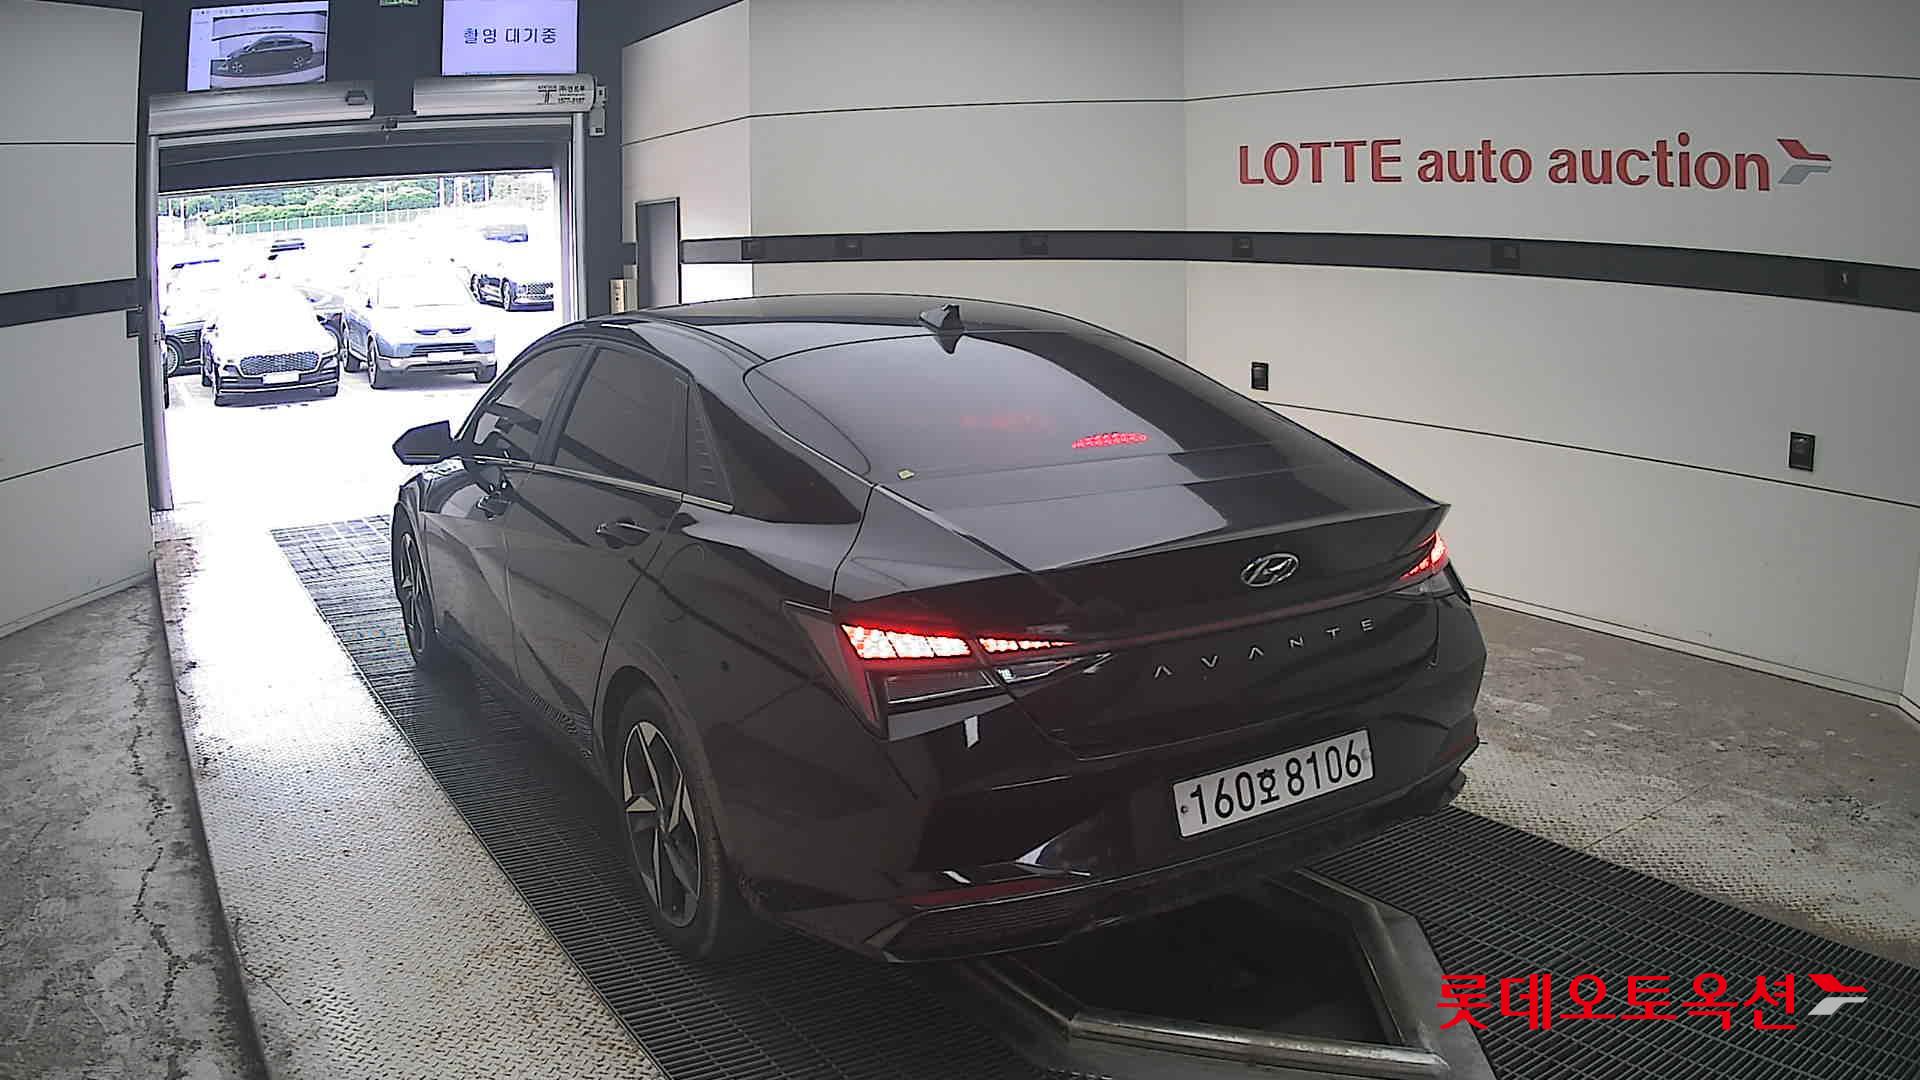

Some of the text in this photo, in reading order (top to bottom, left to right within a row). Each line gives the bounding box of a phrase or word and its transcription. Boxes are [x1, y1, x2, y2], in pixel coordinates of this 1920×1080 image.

[505, 27, 557, 44] 대기중
[1238, 132, 1771, 191] LOTTE auto auction
[1152, 617, 1376, 679] AVANTE
